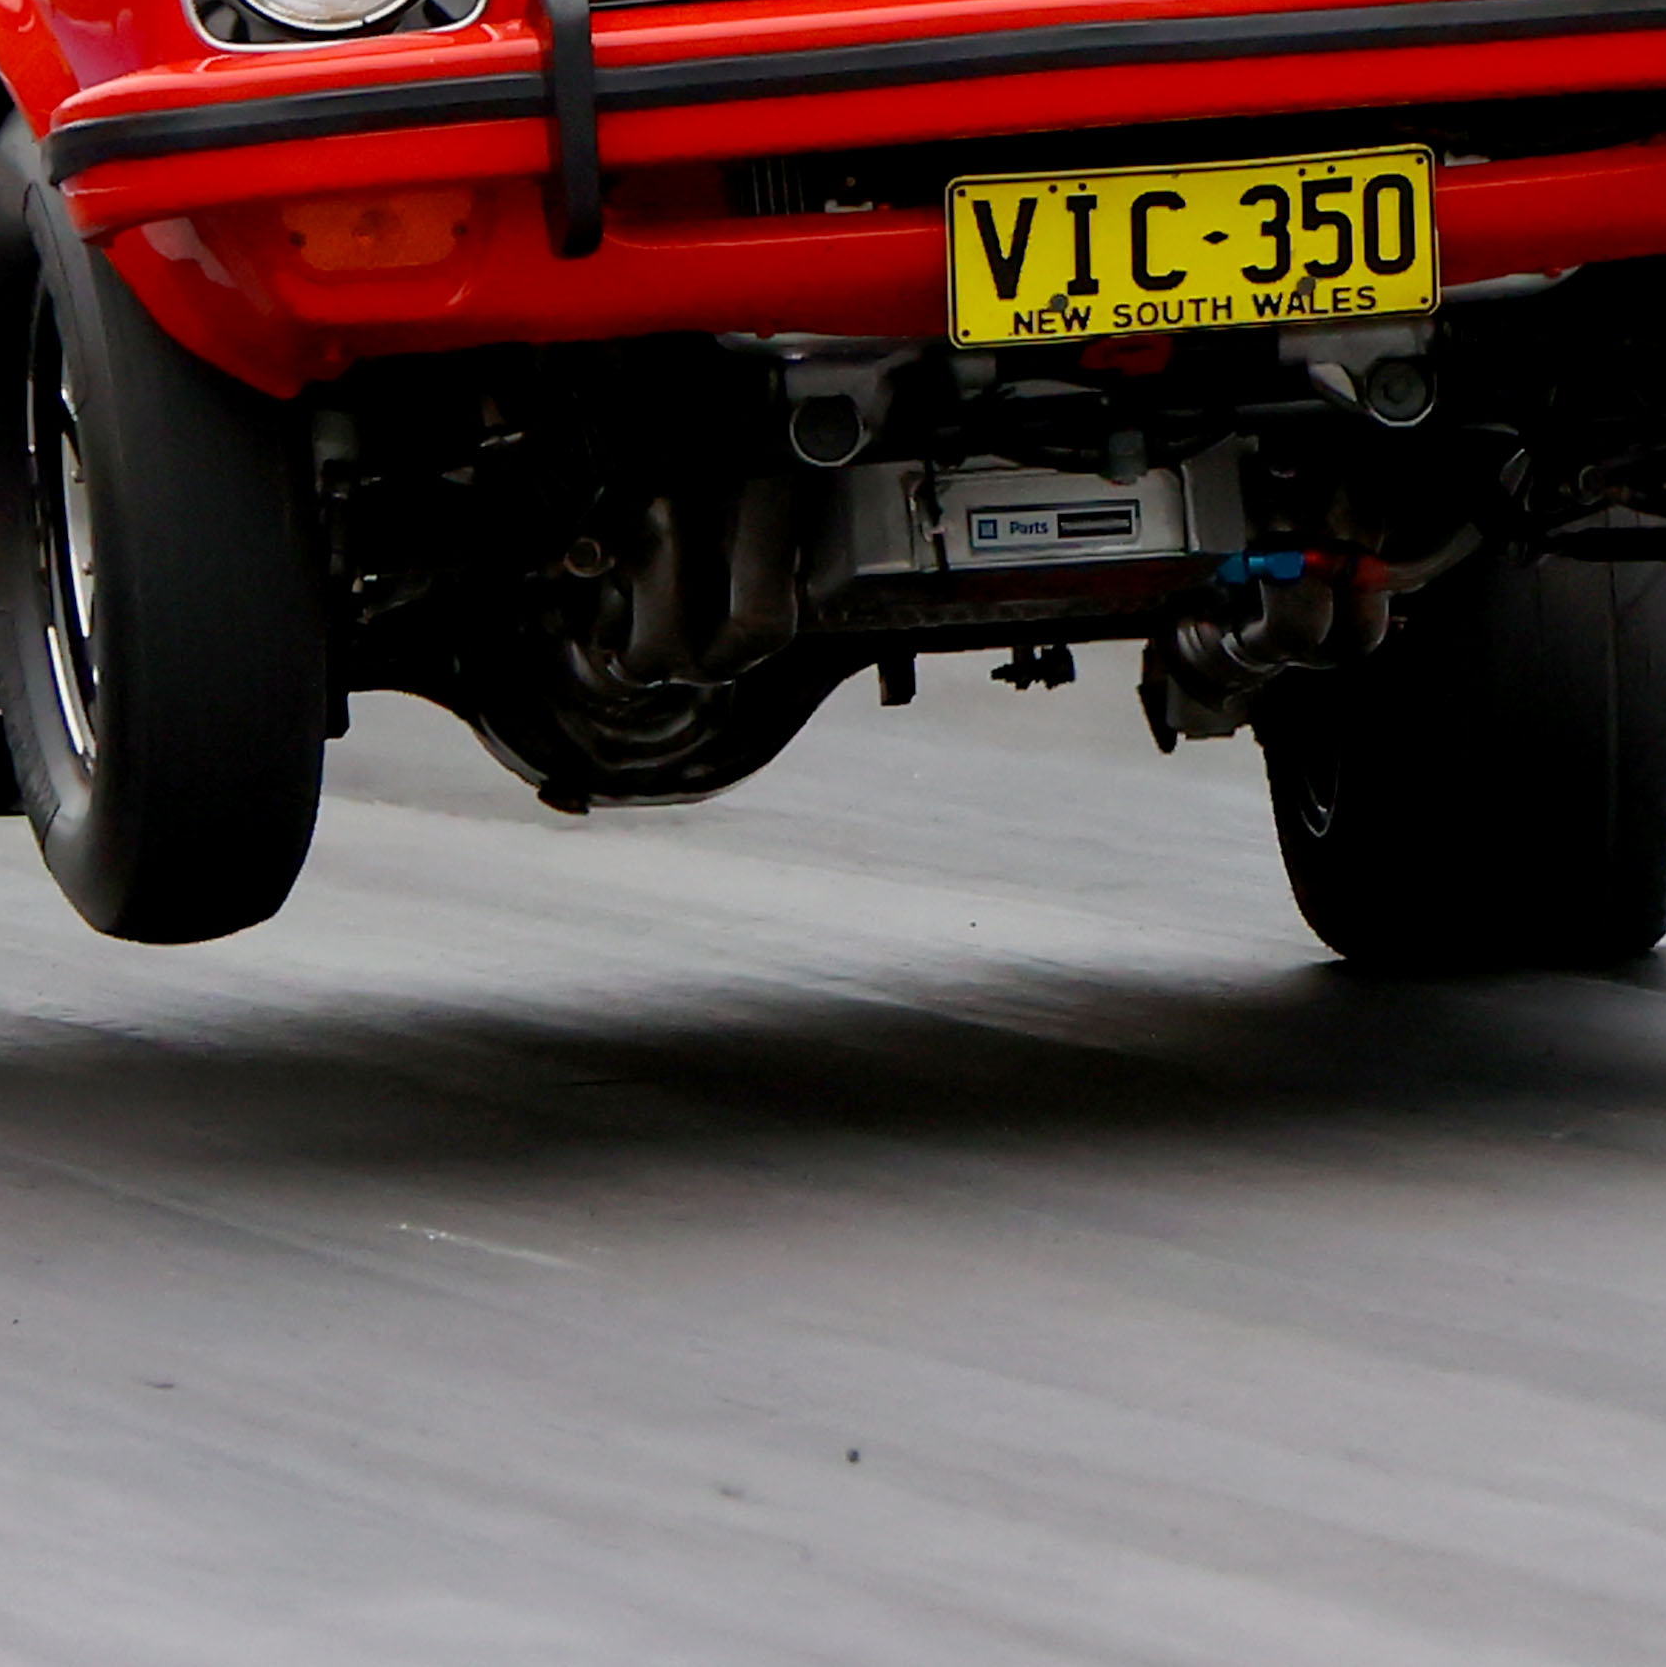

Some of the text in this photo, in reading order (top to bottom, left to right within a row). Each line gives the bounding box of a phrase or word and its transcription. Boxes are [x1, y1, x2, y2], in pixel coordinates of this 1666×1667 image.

[972, 173, 1416, 301] VIC-350
[1013, 285, 1377, 335] NEW SOUTH WALES
[1009, 520, 1050, 535] Parts
